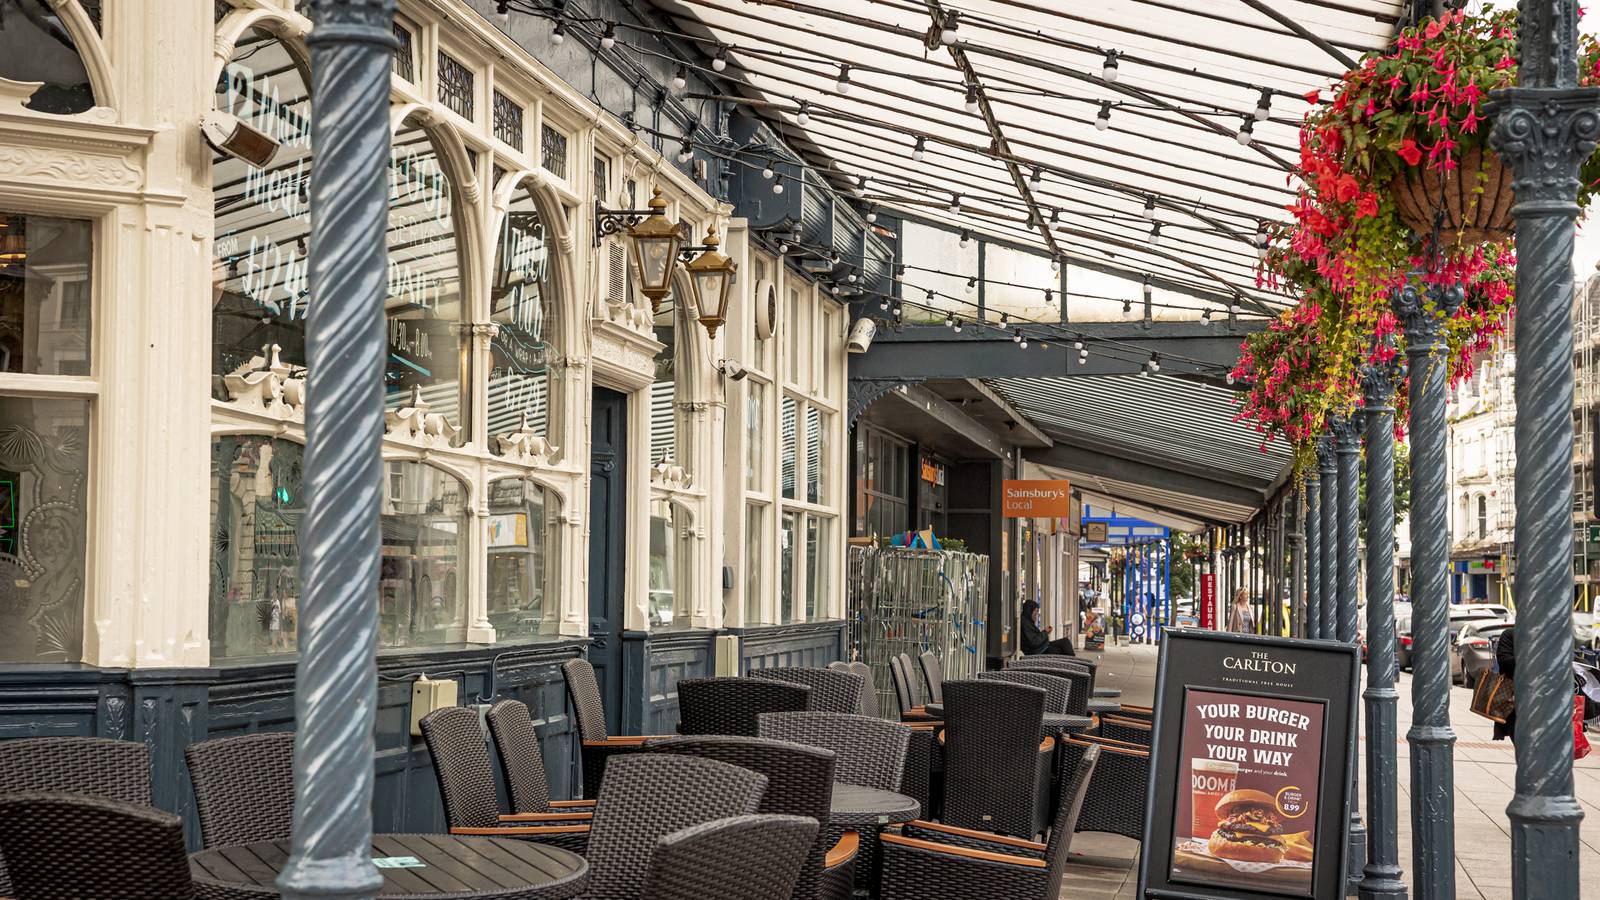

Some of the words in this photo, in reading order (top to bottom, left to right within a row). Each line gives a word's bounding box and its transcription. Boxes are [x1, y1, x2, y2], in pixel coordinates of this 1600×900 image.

[217, 238, 239, 258] FROM
[510, 282, 543, 341] Club
[1007, 488, 1065, 500] Sainsbury's
[1006, 500, 1033, 510] Local
[1251, 651, 1269, 660] THE
[1223, 656, 1297, 675] CARLTON
[1196, 703, 1241, 719] YOUR
[1246, 704, 1310, 731] BURGER
[1204, 724, 1245, 742] YOUR
[1249, 728, 1299, 748] DRINK
[1206, 743, 1248, 762] YOUR
[1253, 748, 1293, 767] WAY
[1283, 803, 1300, 812] 8.99
